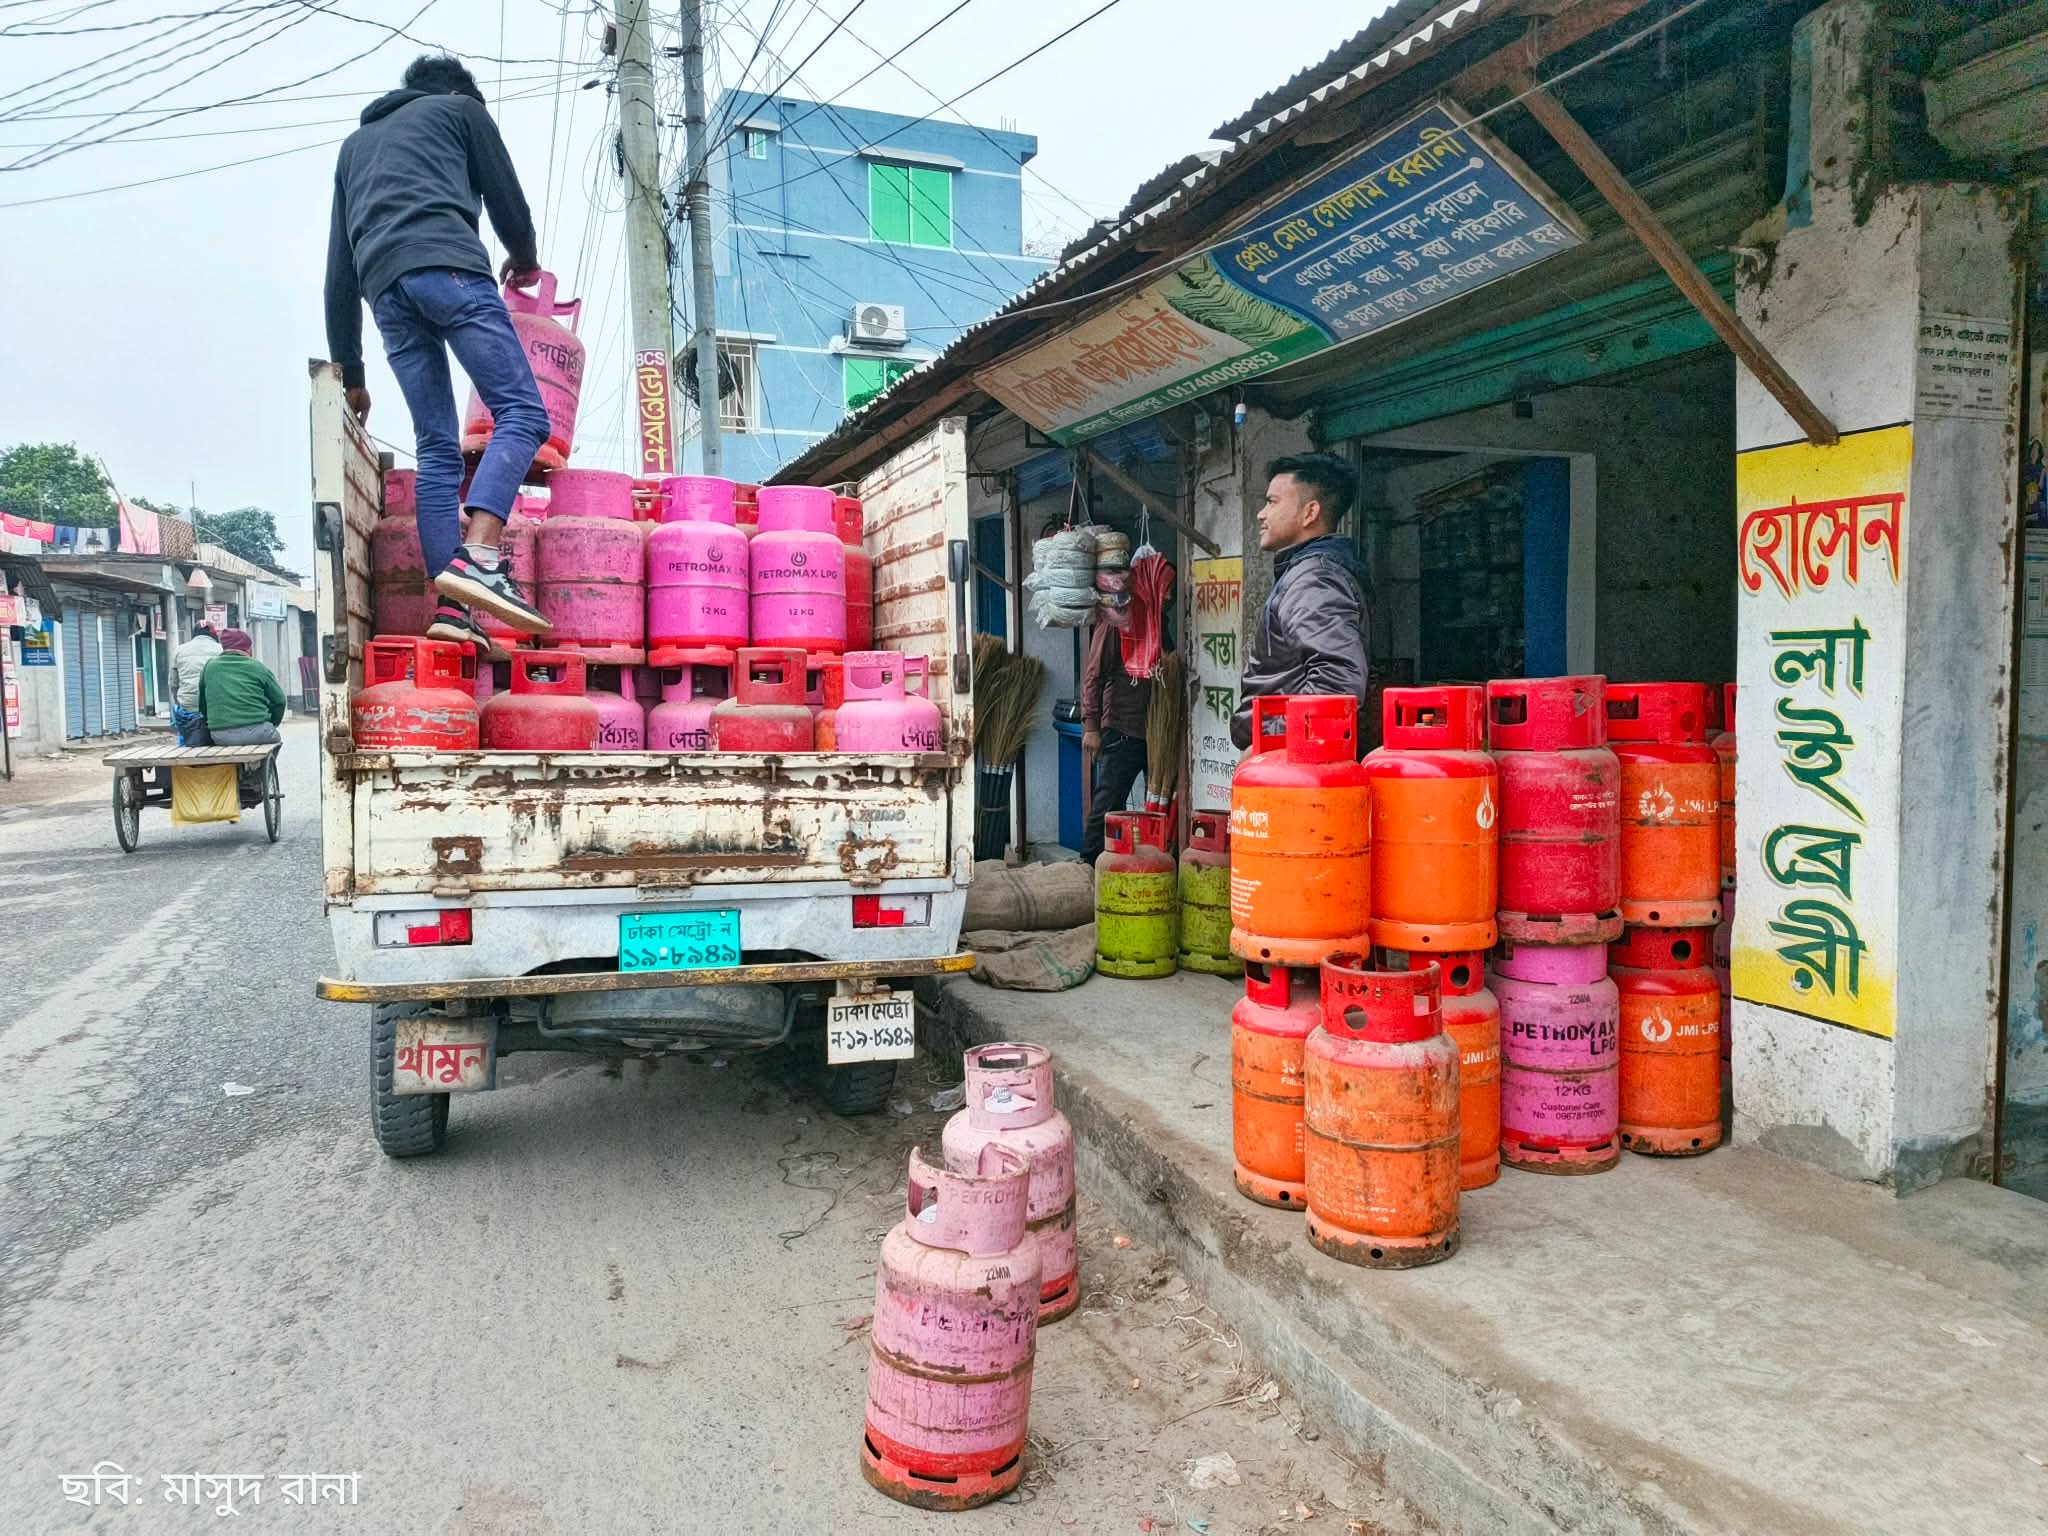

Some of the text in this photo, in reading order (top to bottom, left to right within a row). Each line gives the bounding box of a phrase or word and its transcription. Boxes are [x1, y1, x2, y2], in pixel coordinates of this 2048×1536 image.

[1235, 241, 1279, 272] প্রোঃ
[1273, 217, 1318, 251] মোঃ
[1312, 178, 1390, 228] গোলাম
[1392, 249, 1420, 273] চট
[1451, 199, 1529, 244] পাইকারি
[1295, 258, 1337, 288] এখানে
[1330, 233, 1391, 266] যাবতীয়
[1332, 316, 1349, 331] ও
[1344, 301, 1384, 327] খুচরা
[1488, 235, 1536, 260] করা
[1525, 221, 1570, 246] হয়
[636, 351, 666, 368] BCS
[1167, 350, 1280, 402] 01740008853
[1740, 492, 1906, 600] হোসেন
[669, 562, 732, 574] PETROMAX
[757, 568, 817, 580] PETROMAX
[700, 606, 727, 616] 12 KG
[788, 608, 815, 617] 12 KG
[1201, 628, 1237, 669] বস্তা
[1204, 685, 1235, 722] ঘর
[628, 924, 664, 940] ঢাকা
[623, 944, 737, 968] ১৯-৮৯৪৯
[832, 997, 910, 1022] ঢাকা মেট্রো
[1512, 1021, 1616, 1042] PETROMAX
[1675, 1024, 1699, 1038] JMI
[1590, 1037, 1616, 1056] LPG
[398, 1039, 489, 1084] থামুন
[1463, 1050, 1485, 1065] JMI
[1572, 1086, 1592, 1097] KG
[1540, 1102, 1581, 1112] Customer
[984, 1265, 1012, 1282] 22MM
